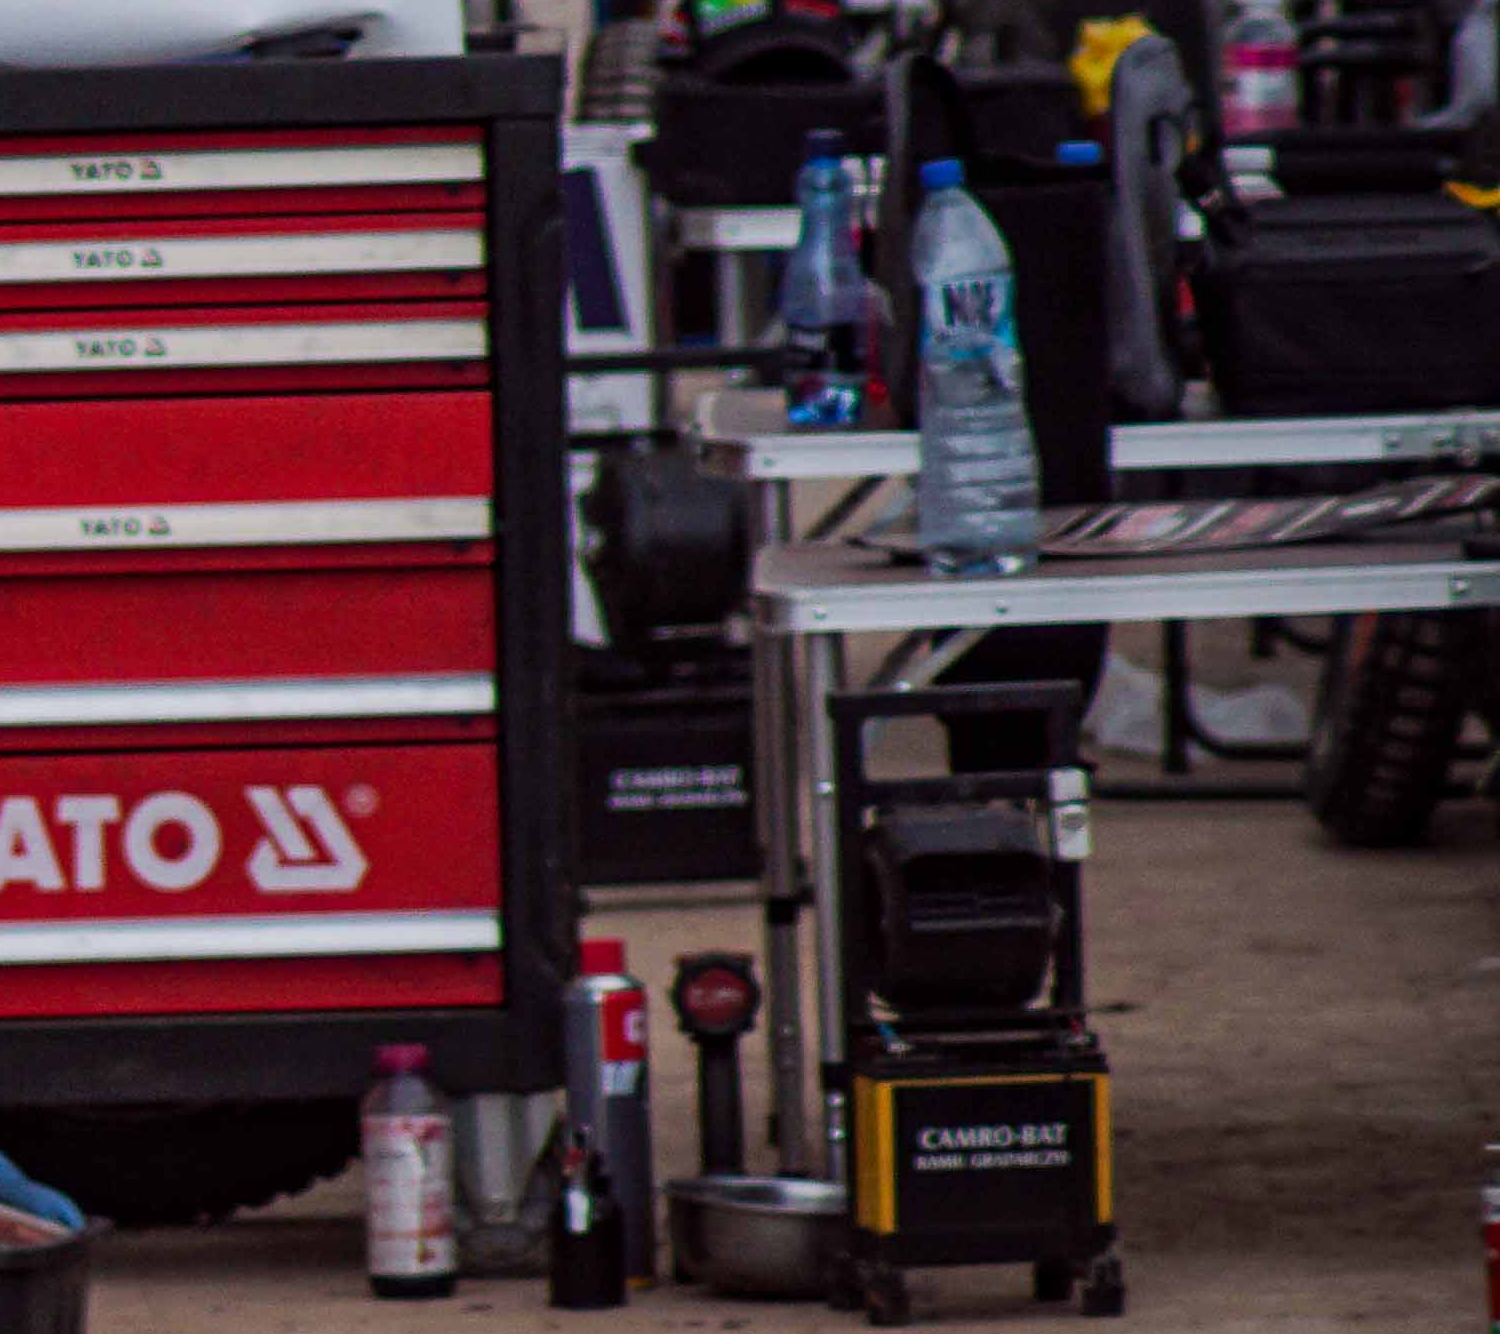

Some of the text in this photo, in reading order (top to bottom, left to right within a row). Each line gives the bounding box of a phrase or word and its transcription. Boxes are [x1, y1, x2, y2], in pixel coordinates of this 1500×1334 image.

[72, 162, 134, 181] YATO
[74, 250, 135, 269] YATO
[76, 338, 137, 357] YATO
[80, 518, 141, 538] YATO
[920, 1122, 1068, 1149] CAMRO-BAT
